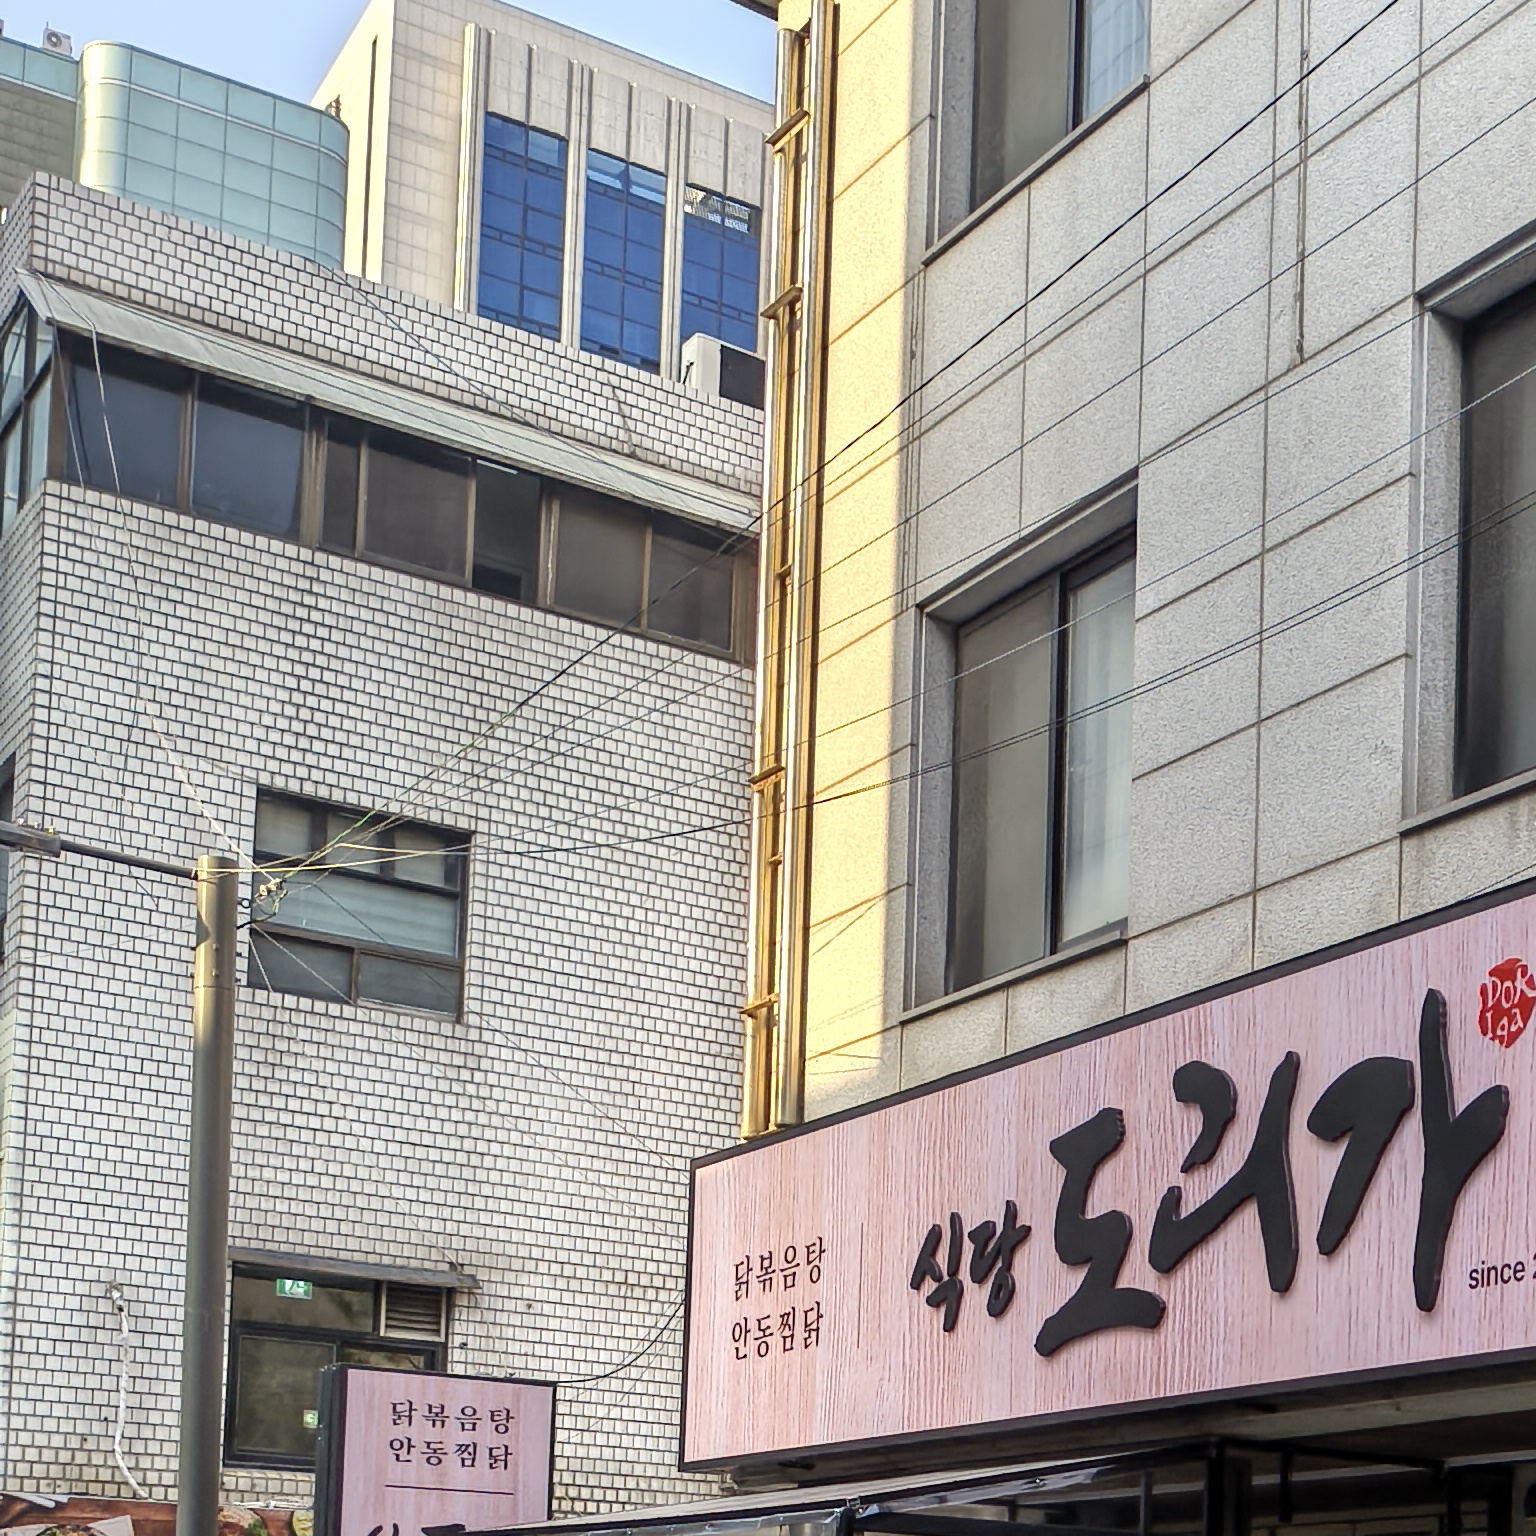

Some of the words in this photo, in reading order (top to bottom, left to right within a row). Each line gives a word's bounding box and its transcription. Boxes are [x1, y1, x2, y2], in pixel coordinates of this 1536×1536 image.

[909, 1199, 1032, 1333] 식당
[1034, 987, 1510, 1358] 도리가
[732, 1236, 826, 1302] 닭볶음탕
[1467, 1252, 1526, 1291] since
[730, 1301, 825, 1361] 안동찜닭
[389, 1399, 516, 1435] 닭볶음탕
[388, 1435, 514, 1471] 안동찜닭
